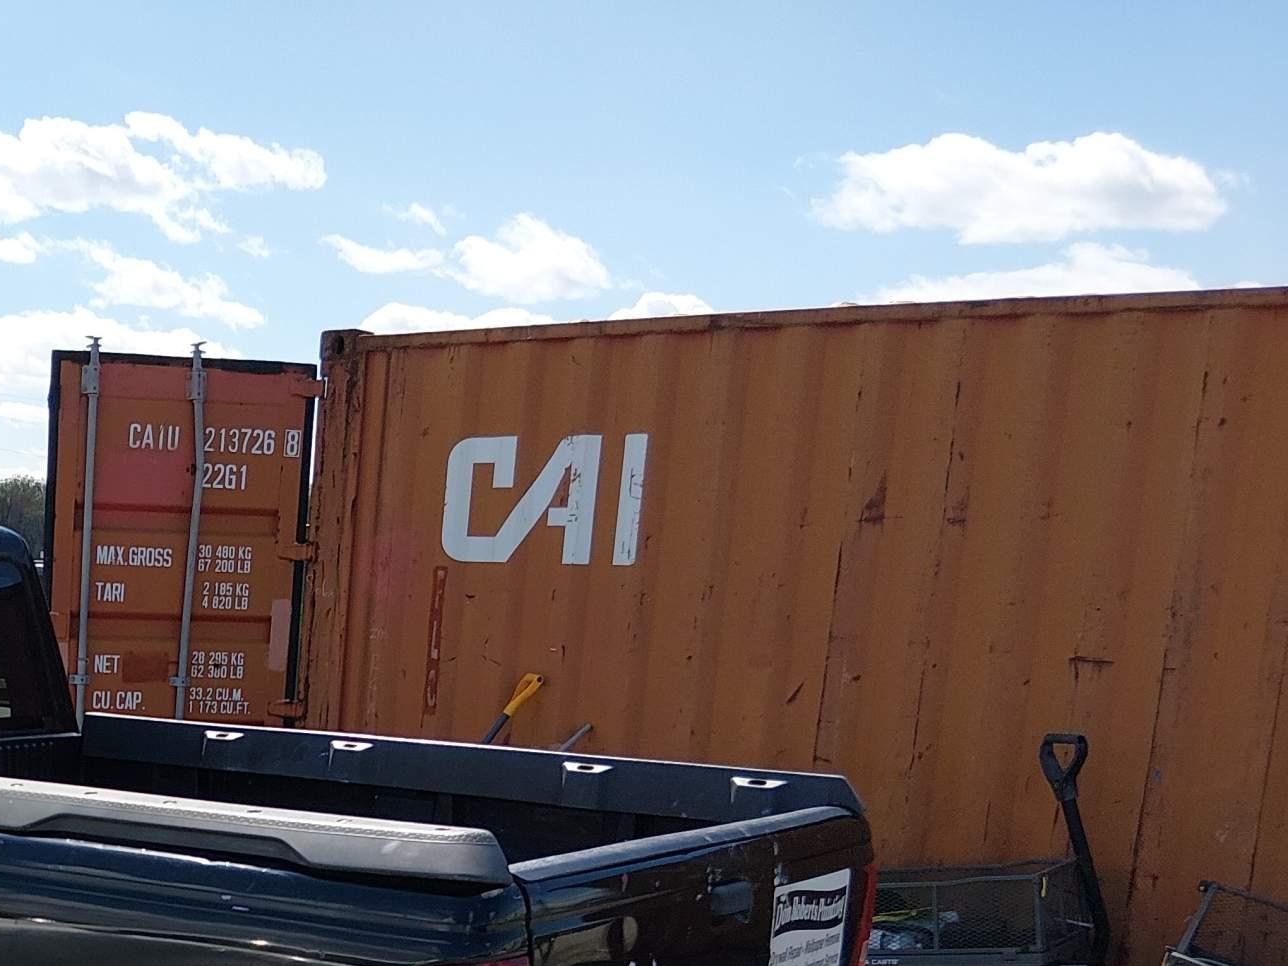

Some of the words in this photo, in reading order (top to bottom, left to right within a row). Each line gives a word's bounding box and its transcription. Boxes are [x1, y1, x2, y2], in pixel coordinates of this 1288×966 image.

[128, 423, 180, 450] CAIU
[204, 427, 275, 455] 213726
[286, 431, 300, 456] 8
[202, 463, 247, 490] 22G1
[441, 433, 648, 566] CAI
[96, 545, 173, 567] MAX.GROSS
[199, 545, 212, 558] 30
[215, 545, 236, 559] 480
[238, 546, 252, 560] KG
[198, 559, 211, 572] 67
[215, 559, 235, 573] 200
[237, 560, 251, 574] LB
[203, 582, 210, 595] 2
[214, 582, 233, 596] 185
[235, 583, 250, 597] KG
[202, 596, 209, 608] 4
[212, 596, 232, 609] 820
[235, 597, 248, 610] LB
[94, 654, 120, 673] NET
[192, 651, 205, 664] 28
[209, 651, 228, 665] 295
[231, 652, 244, 665] KG
[191, 665, 203, 678] 62
[230, 666, 244, 679] LB
[189, 687, 213, 700] 33.2
[215, 687, 244, 701] CU.M.
[189, 701, 193, 713] 1
[199, 701, 217, 714] 173
[220, 701, 251, 715] CU.FT.
